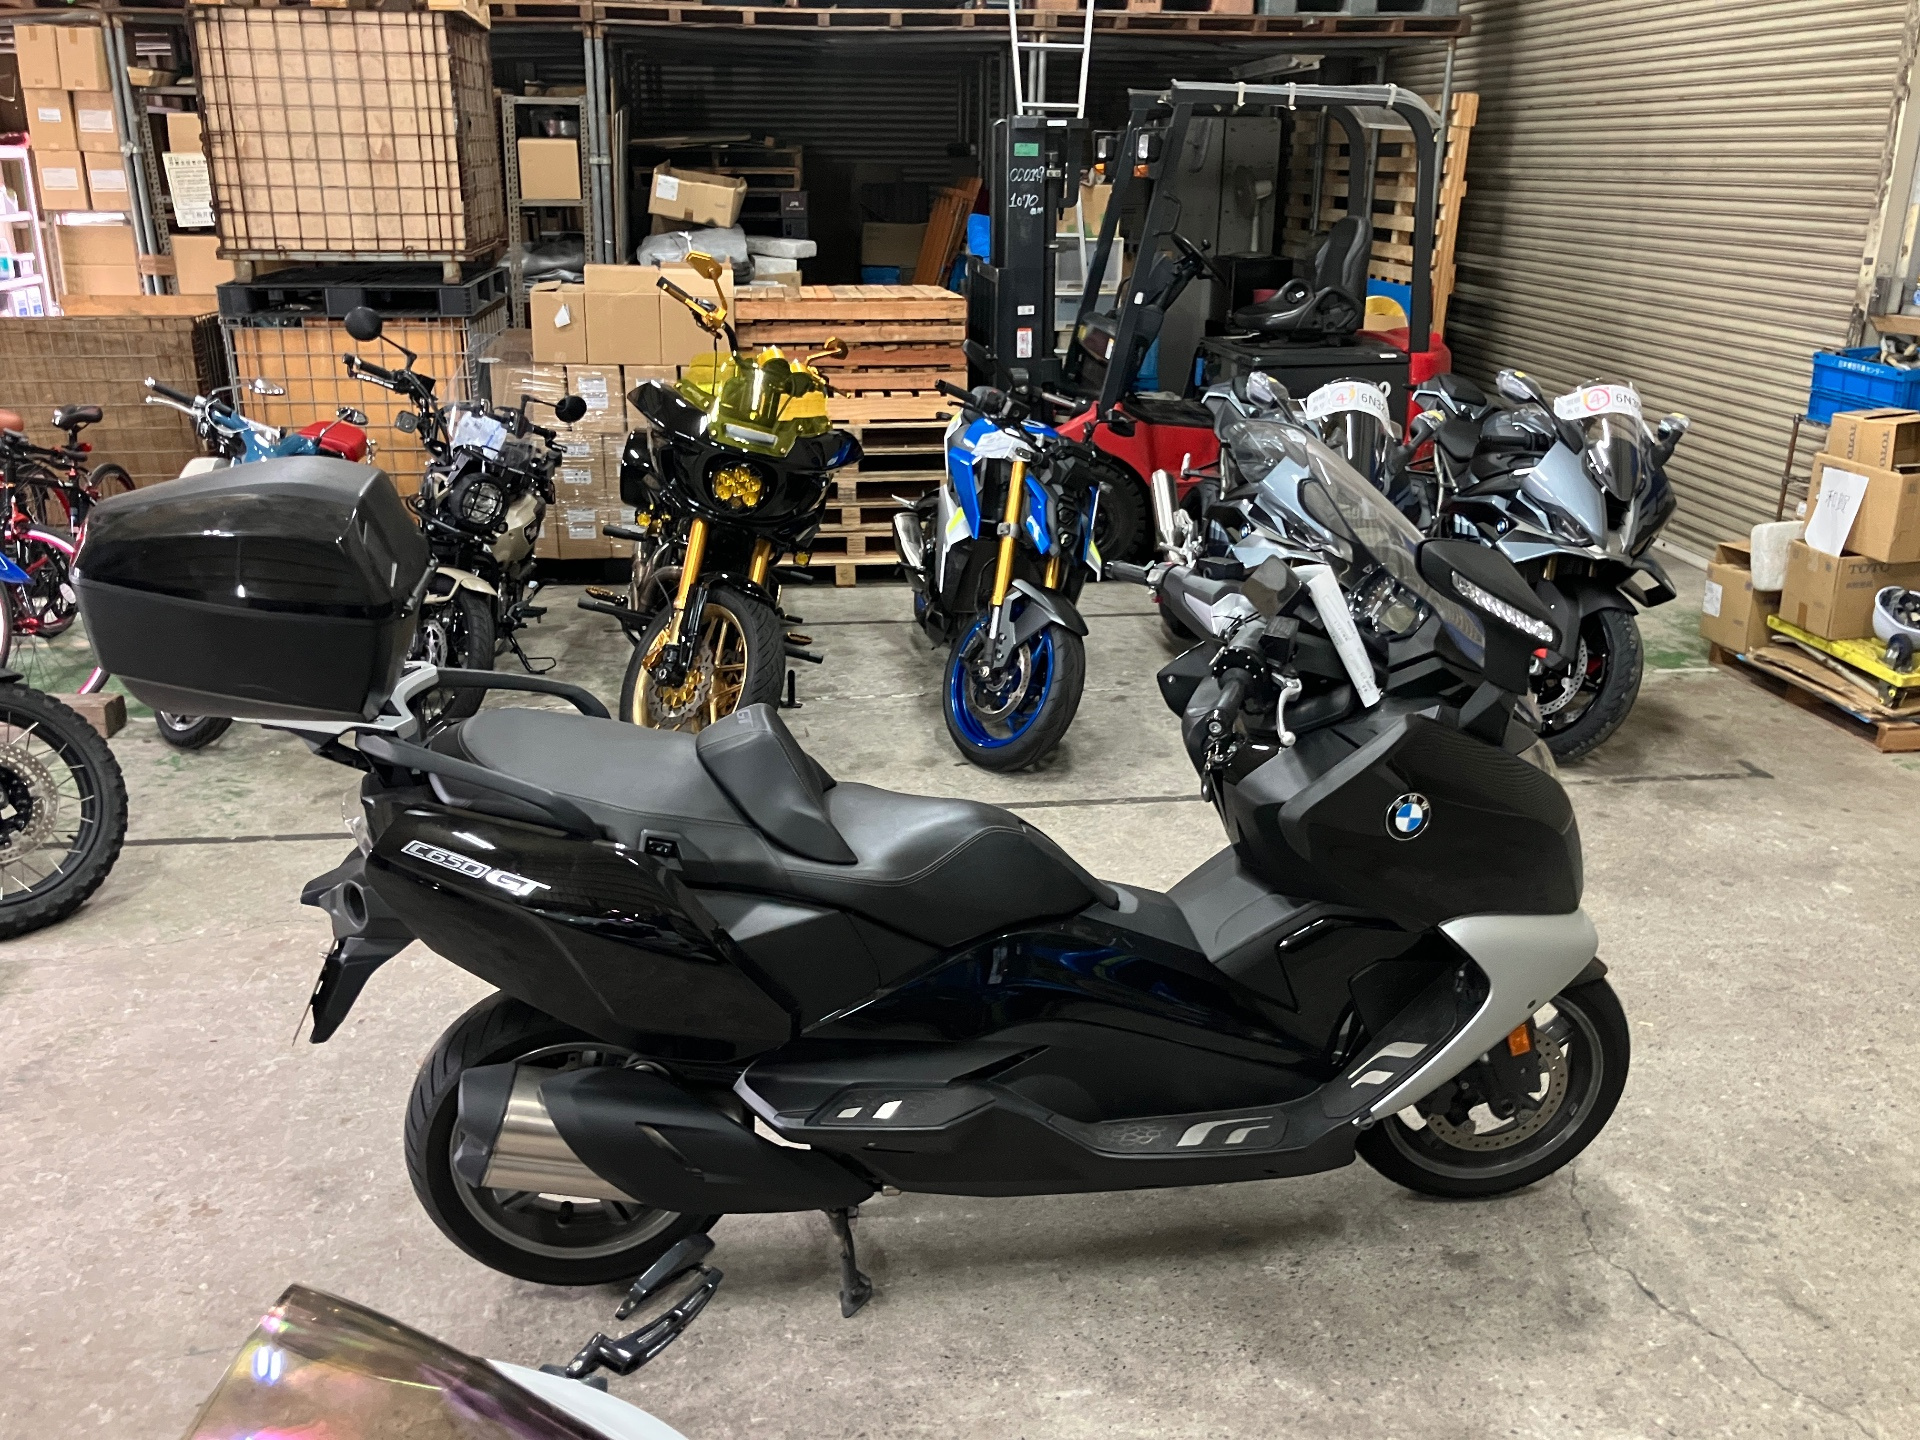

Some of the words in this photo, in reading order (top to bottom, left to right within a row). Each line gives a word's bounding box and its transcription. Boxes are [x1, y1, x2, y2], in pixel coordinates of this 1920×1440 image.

[1008, 192, 1039, 209] 1070
[1847, 424, 1858, 460] TOTO
[1879, 431, 1890, 468] TOTO
[1849, 562, 1891, 576] TOTO
